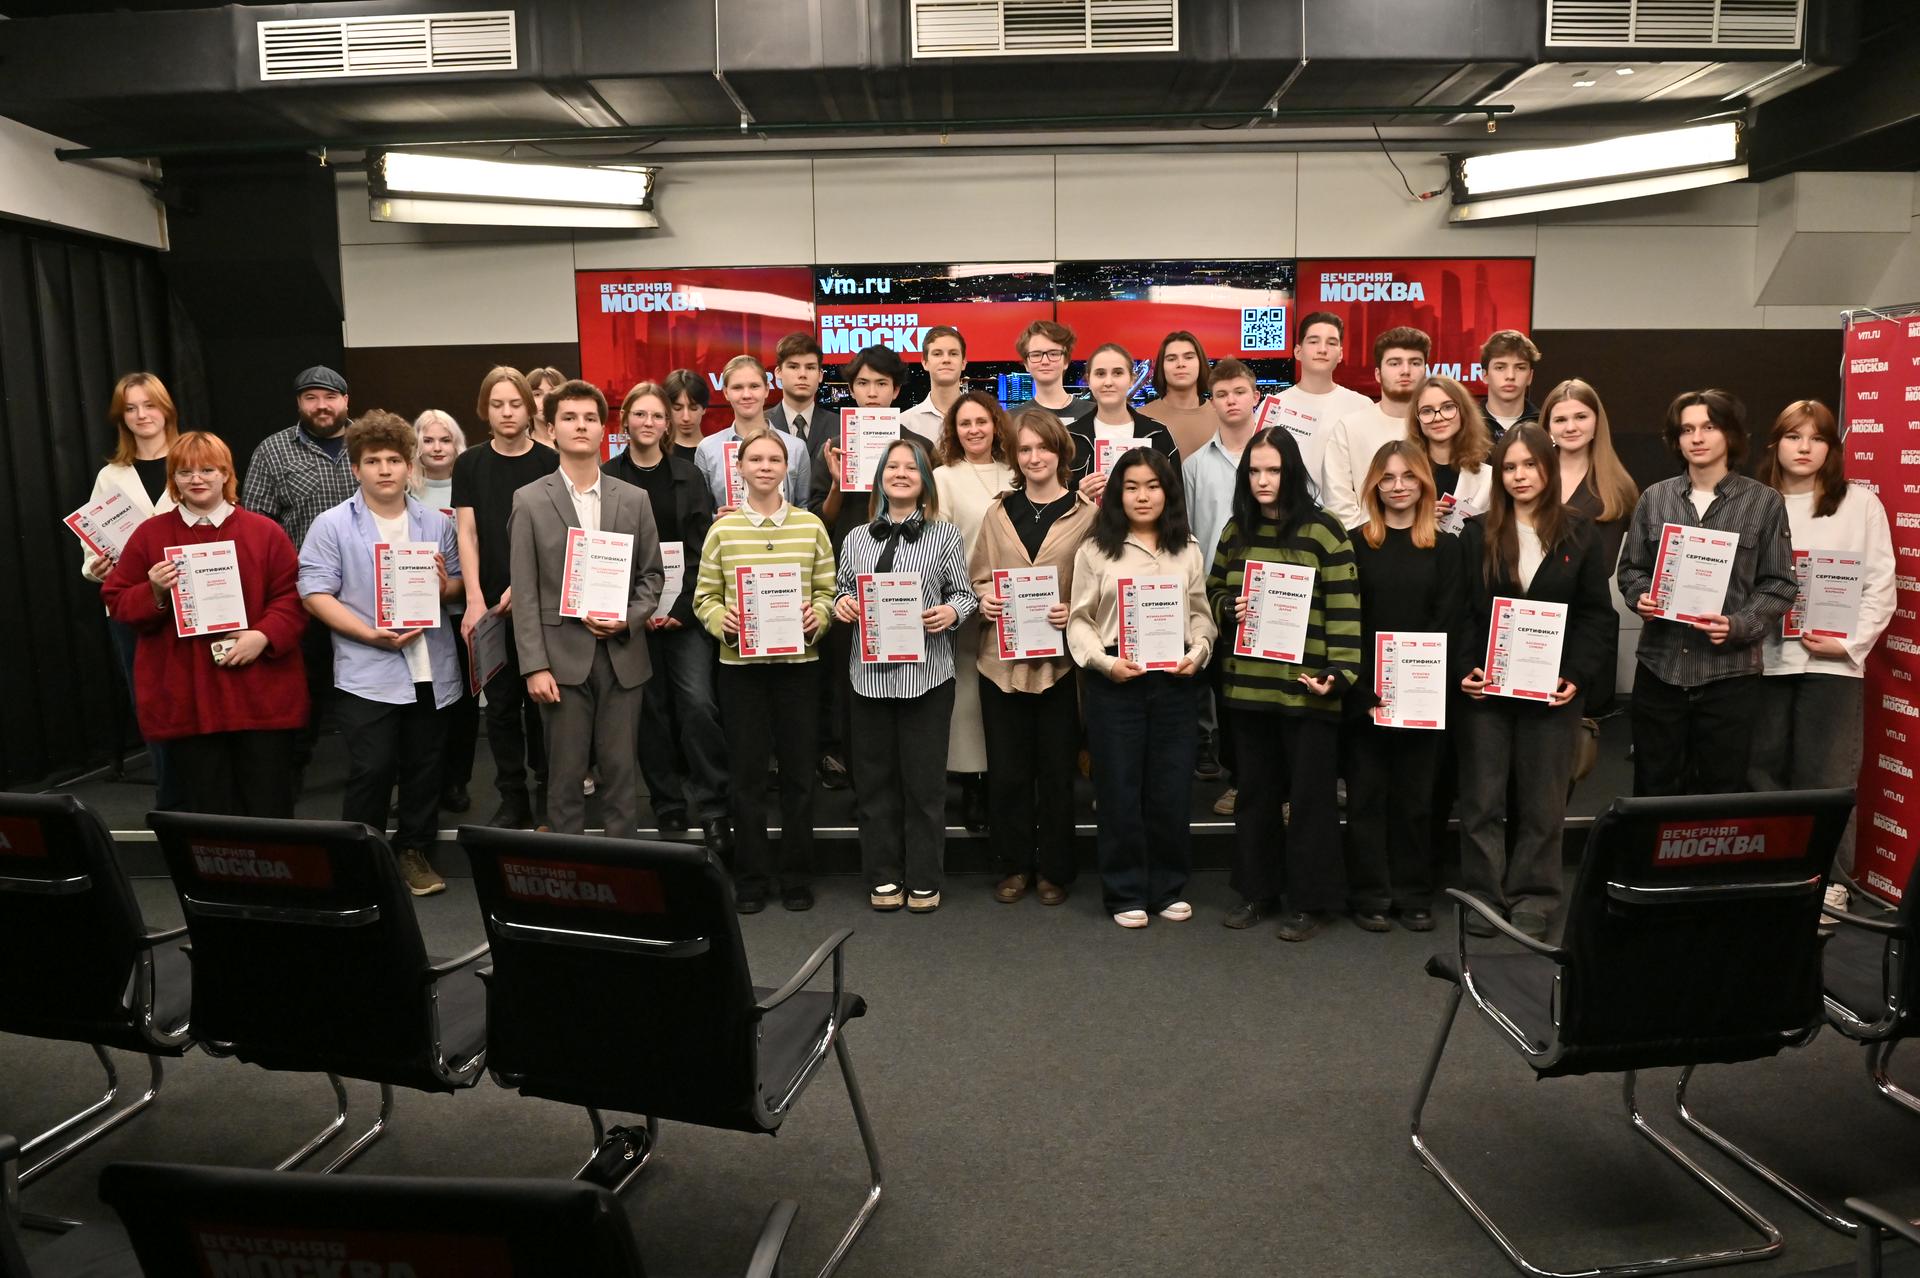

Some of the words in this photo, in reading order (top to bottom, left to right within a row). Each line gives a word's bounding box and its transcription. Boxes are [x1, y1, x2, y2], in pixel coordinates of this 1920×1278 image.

[819, 277, 891, 295] vm.ru
[1320, 272, 1393, 282] ВЕЧЕРНЯЯ
[600, 282, 673, 293] ВЕЧЕРНЯЯ
[1320, 282, 1425, 302] МОСКВА
[600, 292, 706, 313] МОСКВА
[821, 313, 918, 328] ВЕЧЕРНЯЯ
[821, 327, 957, 354] МОСК
[1425, 362, 1483, 382] VM.R
[1850, 361, 1889, 374] МОСКВА
[1851, 423, 1884, 433] МОСКВА
[590, 554, 627, 563] СЕРТИФИКАТ
[1686, 553, 1728, 564] СЕРТИФИКАТ
[195, 565, 234, 574] СЕРТИФИКАТ
[1018, 591, 1055, 599] СЕРТИФИКАТ
[1268, 589, 1307, 599] СЕРТИФИКАТ
[1517, 626, 1559, 636] СЕРТИФИКАТ
[1882, 699, 1920, 718] МОСКВА
[1878, 758, 1914, 779] МОСКВА
[1662, 825, 1739, 840] ВЕЧЕРНЯЯ
[1873, 817, 1908, 839] МОСКВА
[1658, 834, 1765, 860] МОСКВА
[194, 854, 293, 880] МОСКВА
[503, 862, 577, 880] ВЕЧЕРНЯЯ
[506, 874, 617, 904] МОСКВА
[1867, 876, 1903, 899] МОСКВА
[198, 1231, 346, 1259] ВЕЧЕРНЯЯ
